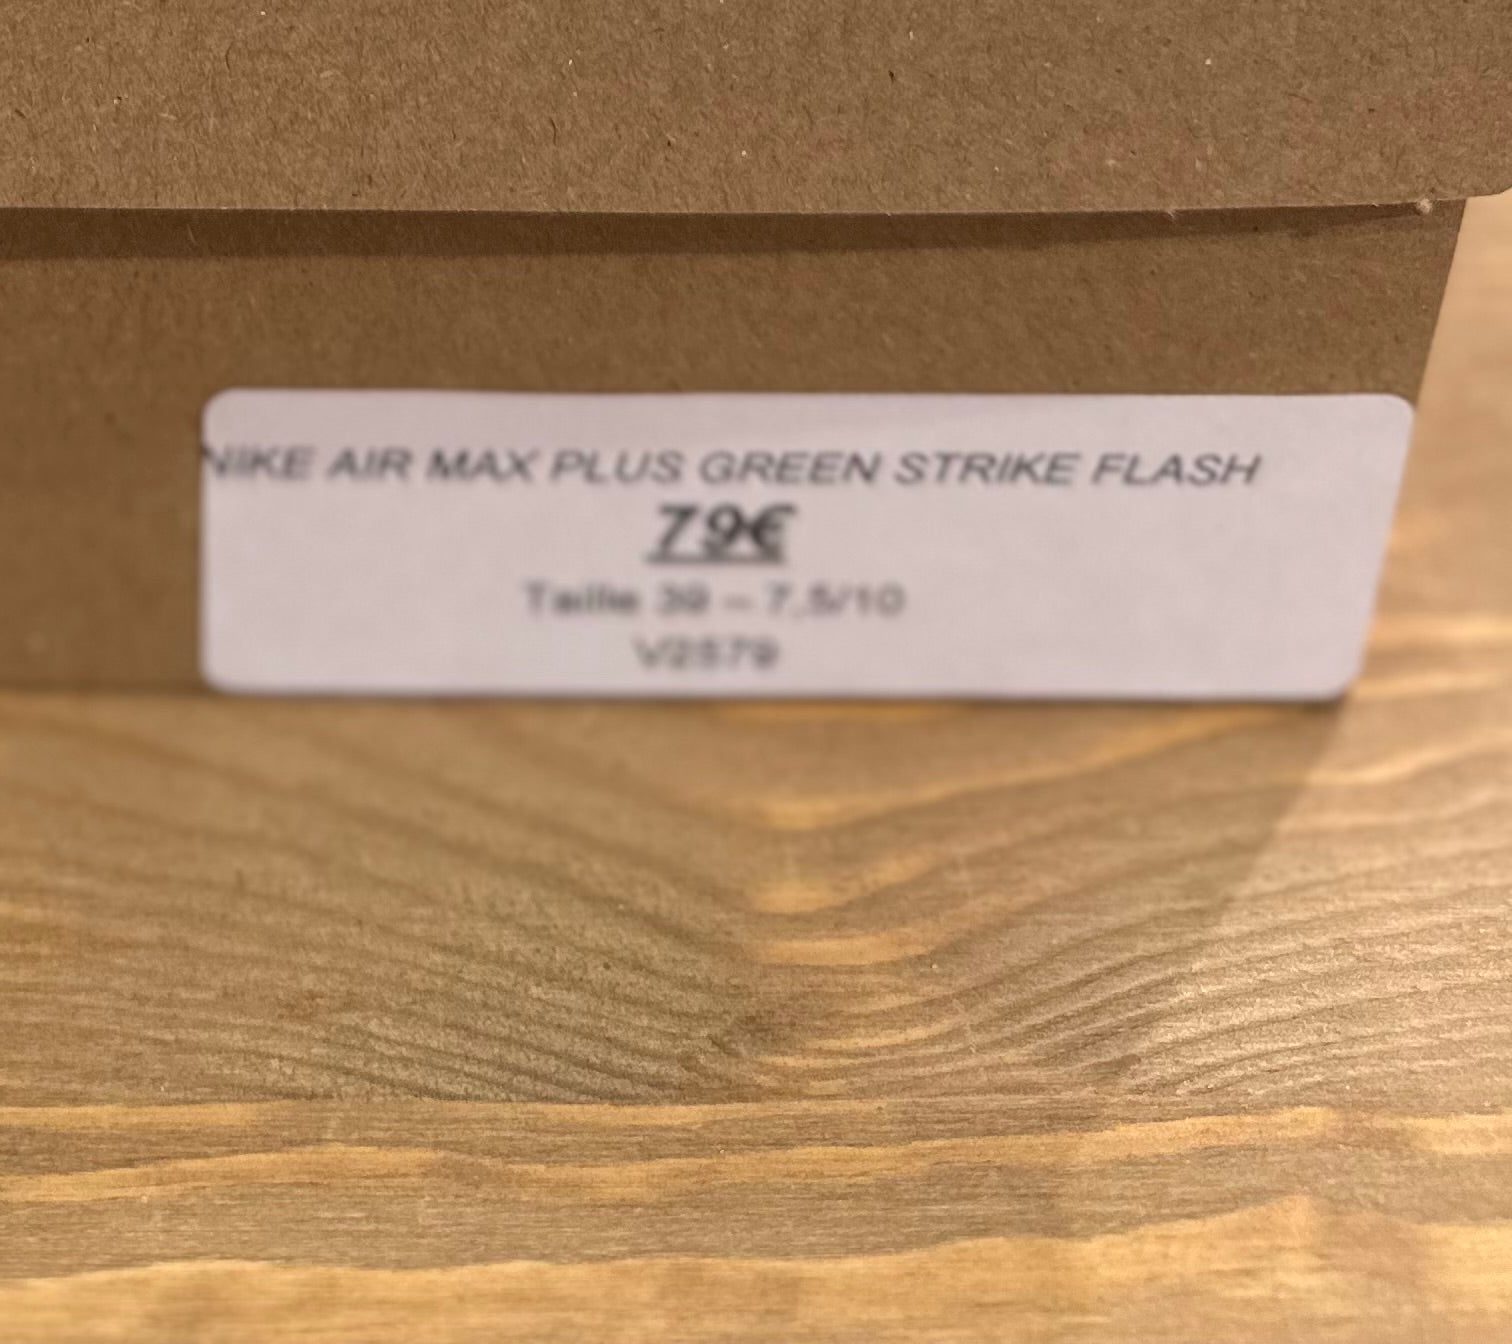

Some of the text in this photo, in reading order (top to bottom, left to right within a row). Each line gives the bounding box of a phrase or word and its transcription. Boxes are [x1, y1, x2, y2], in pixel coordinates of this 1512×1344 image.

[327, 446, 414, 482] AIR
[427, 448, 540, 483] MAX
[549, 450, 684, 484] PLUS
[700, 450, 883, 485] GREEN
[894, 452, 1081, 486] STRIKE
[1091, 453, 1264, 486] FLASH
[646, 502, 798, 565] 79€
[524, 580, 640, 616] Taille
